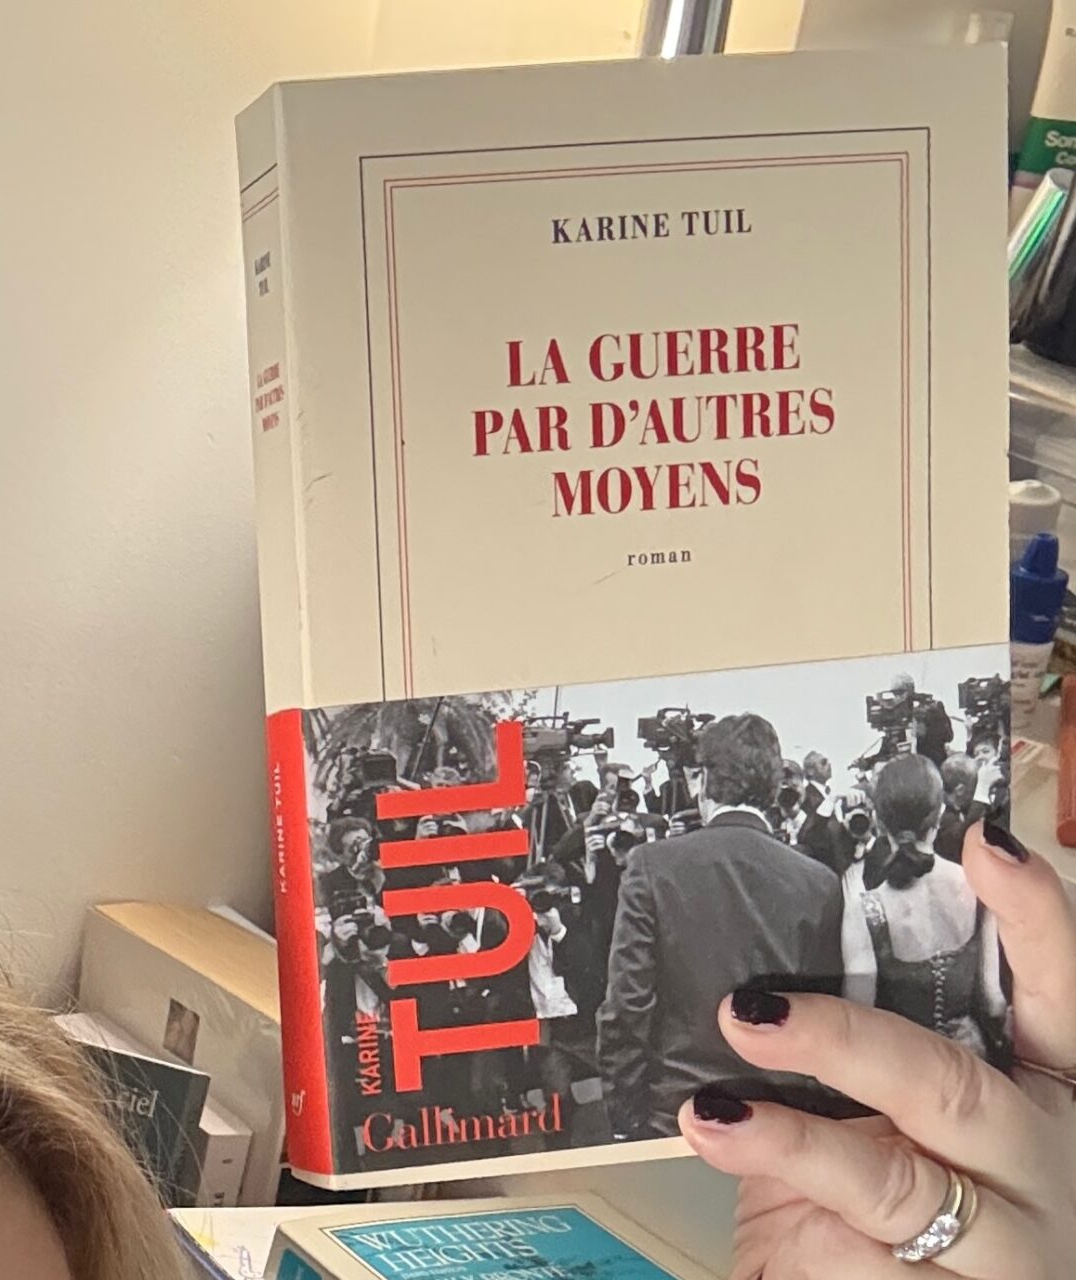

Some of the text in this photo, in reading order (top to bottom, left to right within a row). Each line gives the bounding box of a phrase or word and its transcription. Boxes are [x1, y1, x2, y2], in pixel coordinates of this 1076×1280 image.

[552, 208, 753, 245] KARINE TUIL
[505, 323, 801, 388] LA GUERRE
[471, 387, 835, 457] PAR D'AUTRES
[551, 457, 761, 518] MOYENS
[627, 548, 692, 566] roman
[376, 720, 540, 1092] TUIL
[356, 1011, 382, 1096] KARINE
[124, 1087, 160, 1118] iel
[363, 1092, 564, 1152] Gallimard
[354, 1215, 572, 1252] WUTHERING
[378, 1239, 538, 1272] HEIGHTS
